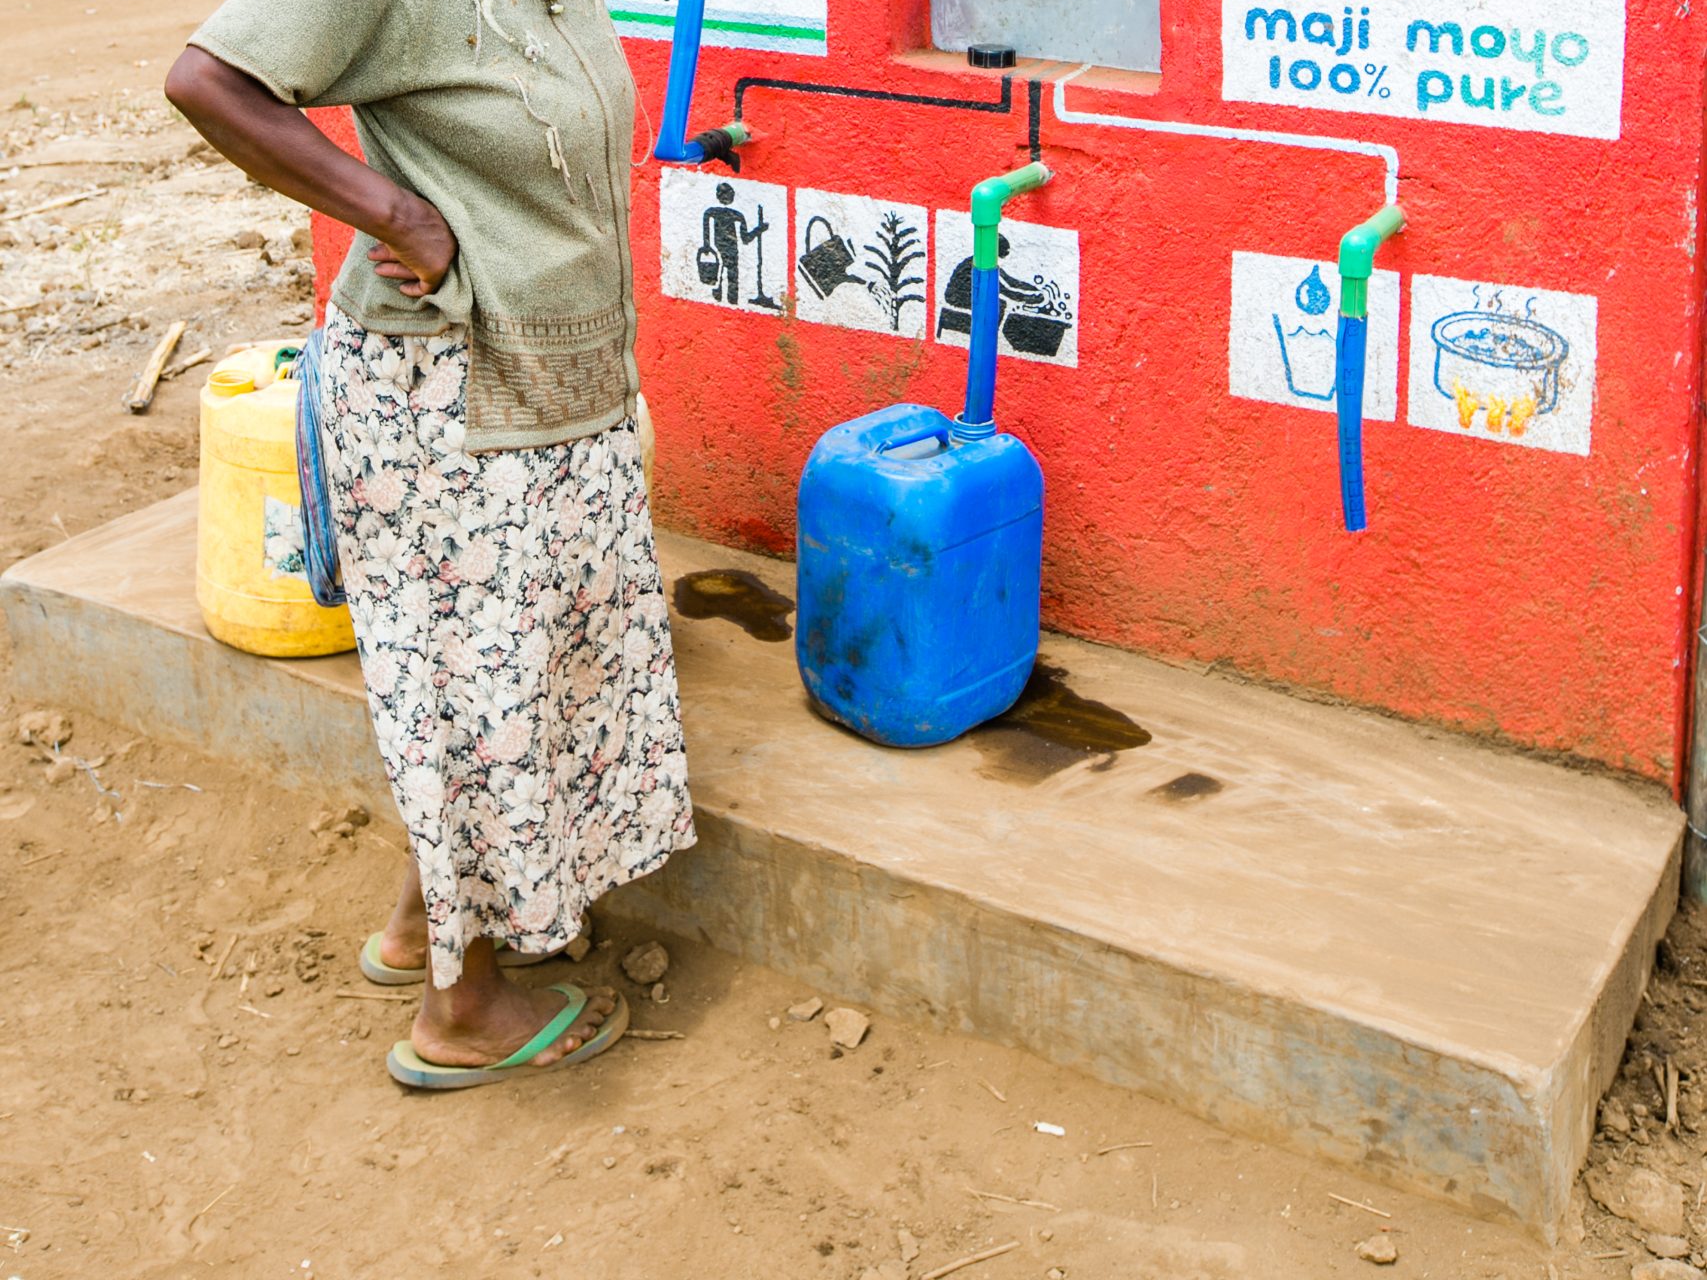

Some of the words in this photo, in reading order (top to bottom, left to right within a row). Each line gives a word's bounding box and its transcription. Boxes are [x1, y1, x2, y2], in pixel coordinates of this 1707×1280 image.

[1245, 6, 1370, 56] maji
[1406, 20, 1589, 78] moyo
[1269, 55, 1391, 99] 100%
[1417, 70, 1566, 116] pure
